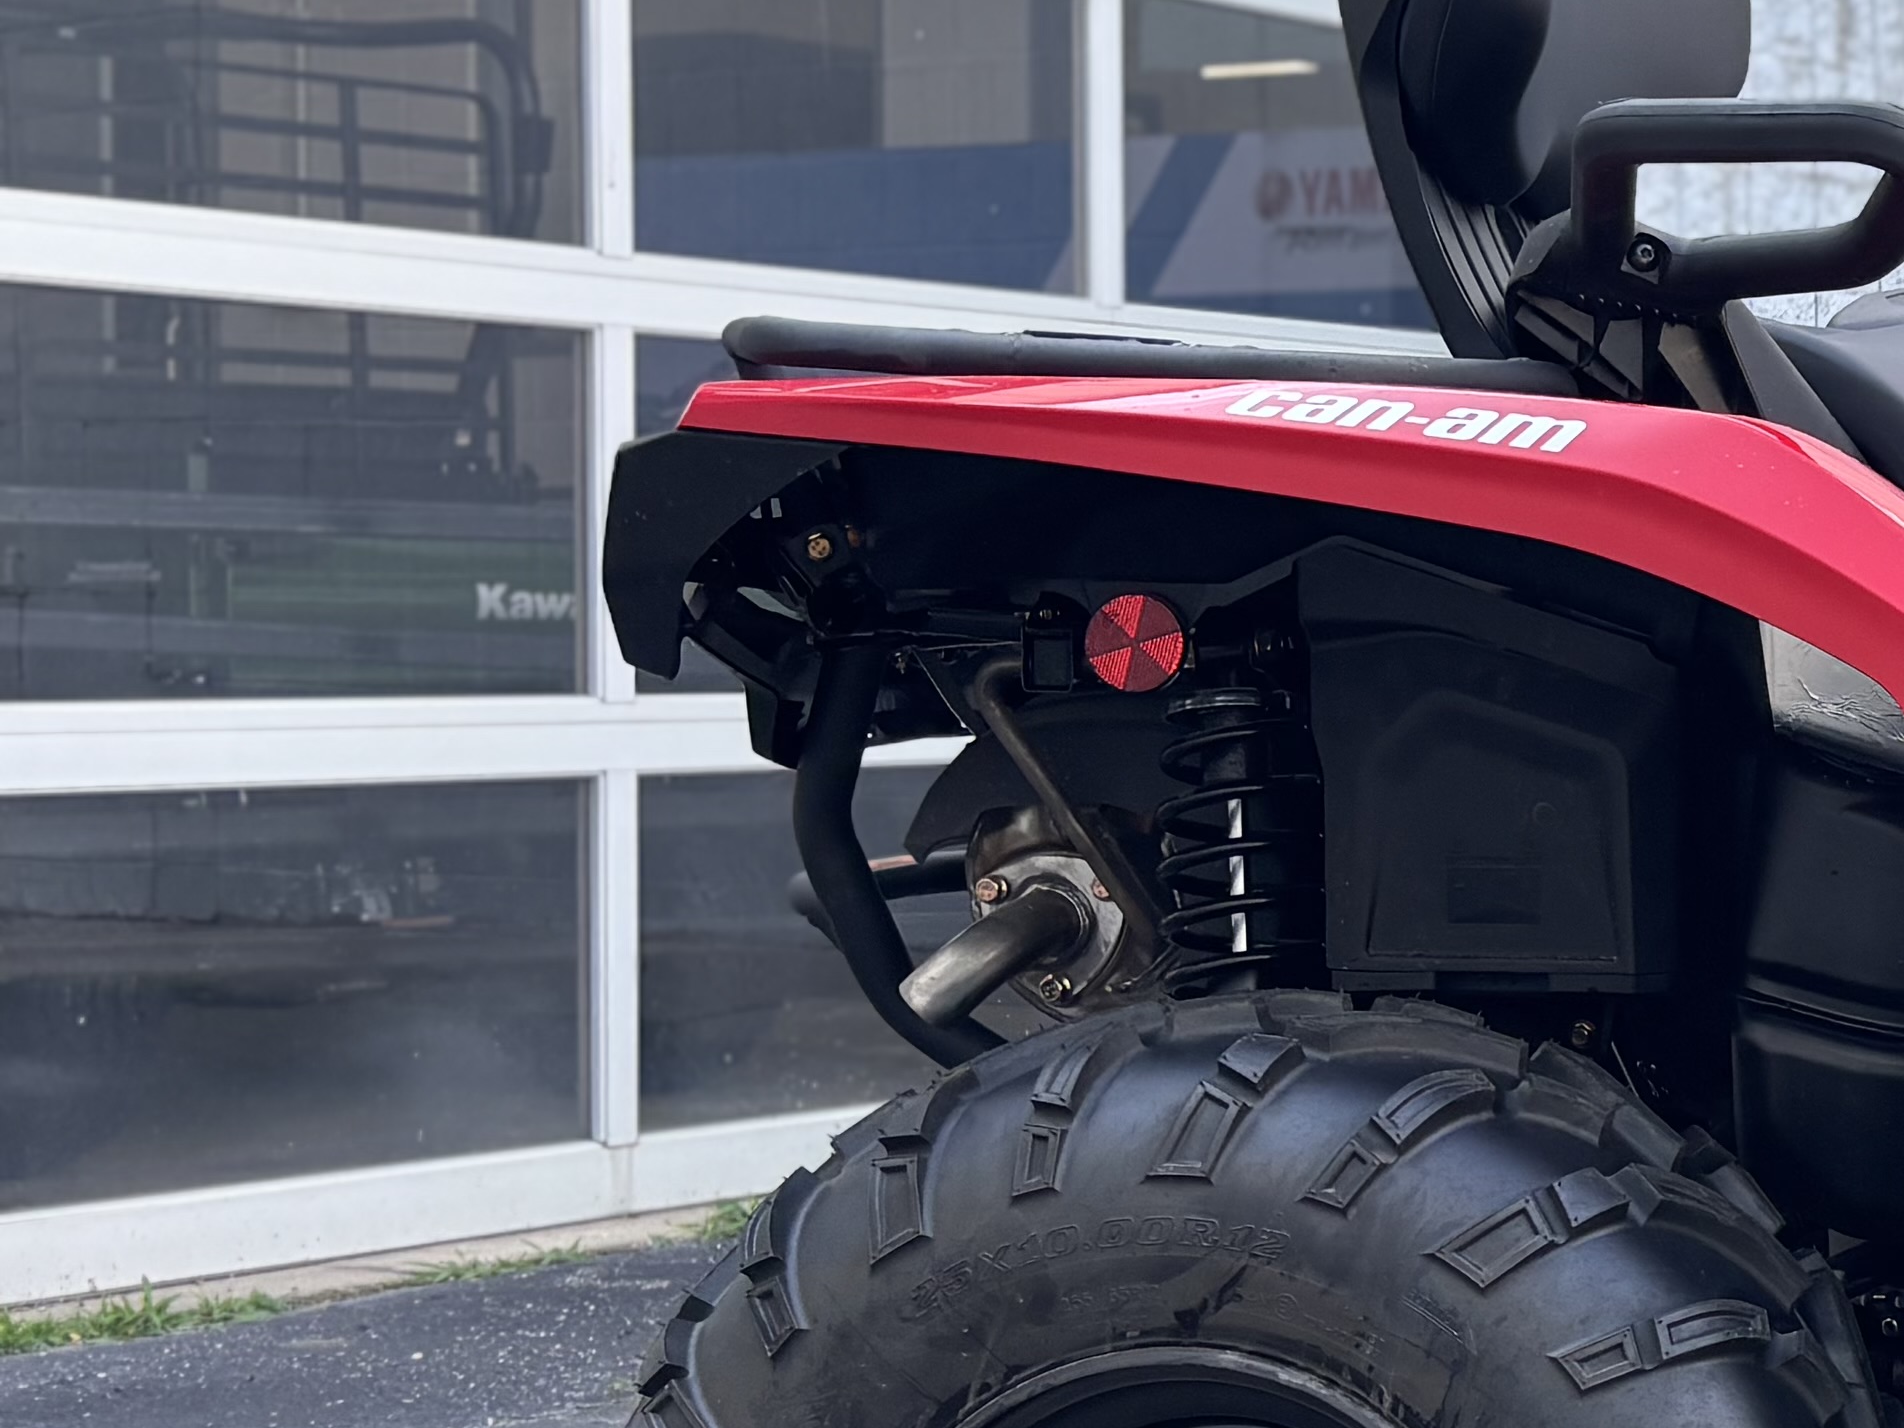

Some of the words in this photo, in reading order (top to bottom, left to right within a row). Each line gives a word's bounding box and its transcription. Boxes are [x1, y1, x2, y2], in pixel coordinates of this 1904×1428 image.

[1300, 166, 1390, 218] YAM
[1224, 388, 1588, 454] can-am
[475, 581, 576, 621] Kaw
